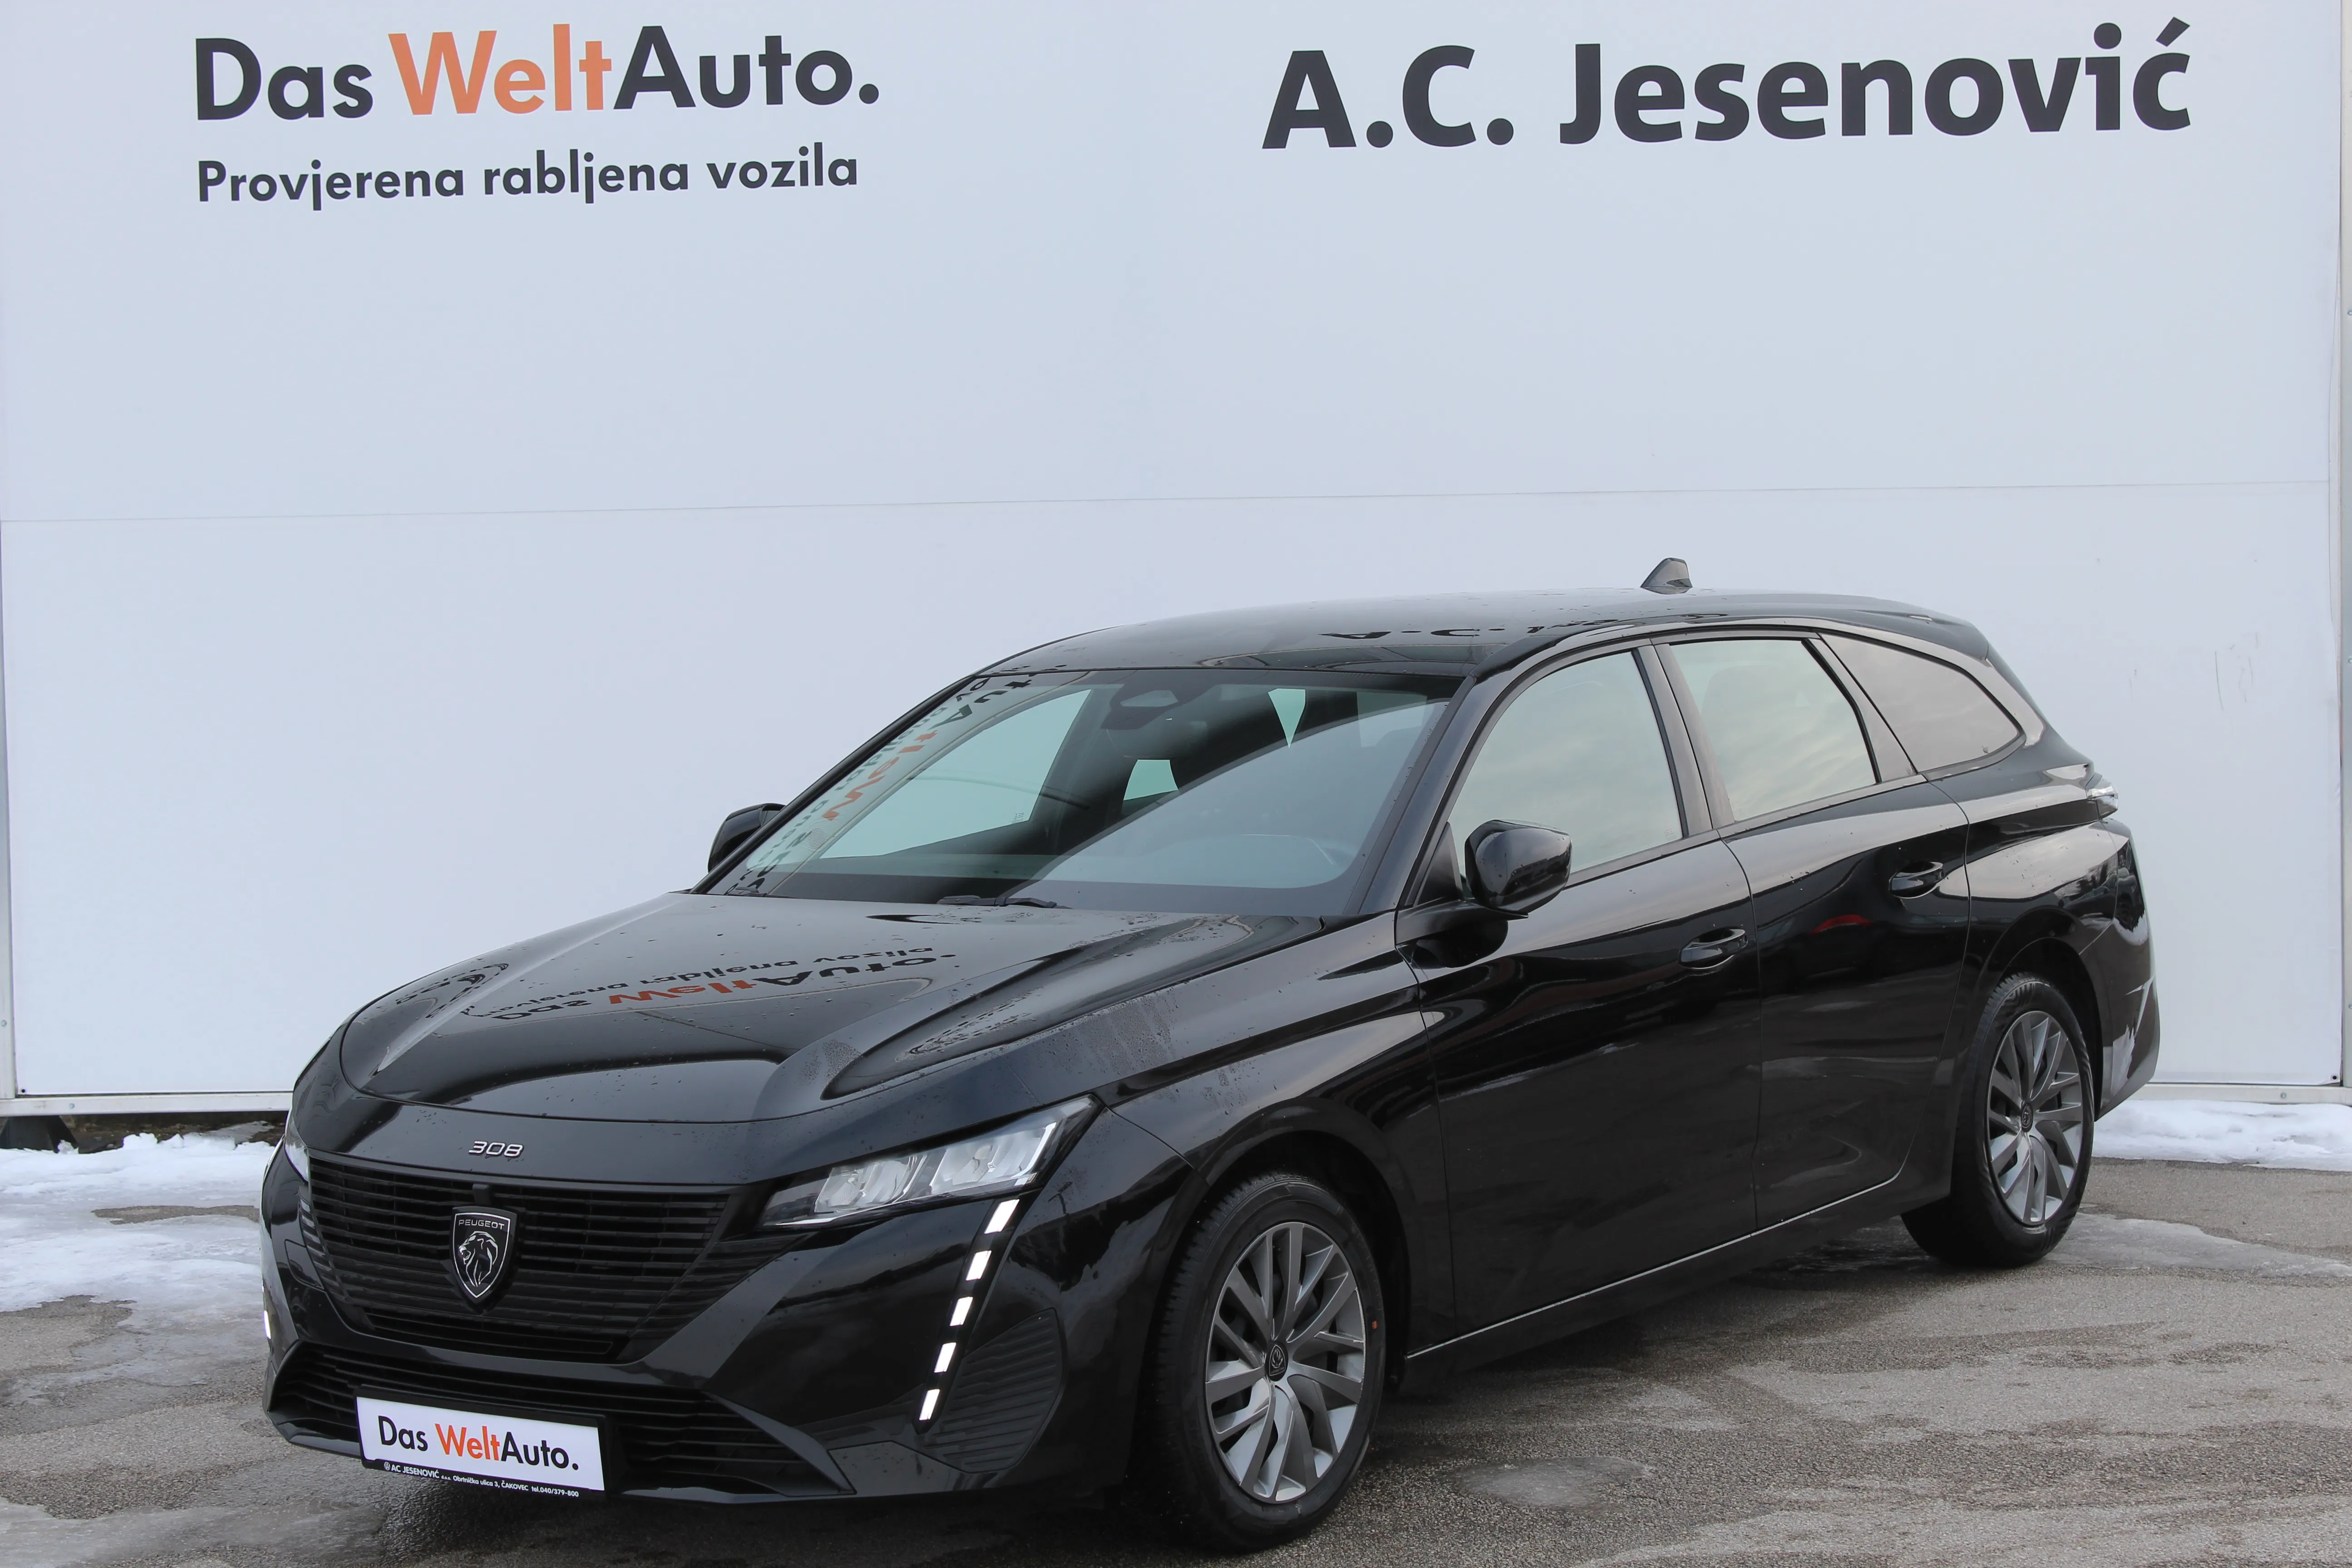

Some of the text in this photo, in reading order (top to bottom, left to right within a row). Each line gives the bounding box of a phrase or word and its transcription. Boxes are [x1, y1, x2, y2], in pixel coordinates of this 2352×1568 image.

[196, 24, 879, 120] Das WeltAuto.
[1262, 17, 2191, 149] A.C. Jesenović
[199, 142, 857, 211] Provjerena rabljena vozila
[468, 1141, 523, 1156] 308
[458, 1219, 505, 1230] PEUGEOT
[378, 1415, 579, 1470] Das WeltAuto.
[391, 1464, 402, 1472] AC
[402, 1466, 440, 1478] JESENOVIĆ
[453, 1475, 479, 1485] Obrtnička
[501, 1480, 529, 1491] ČAKOVEC
